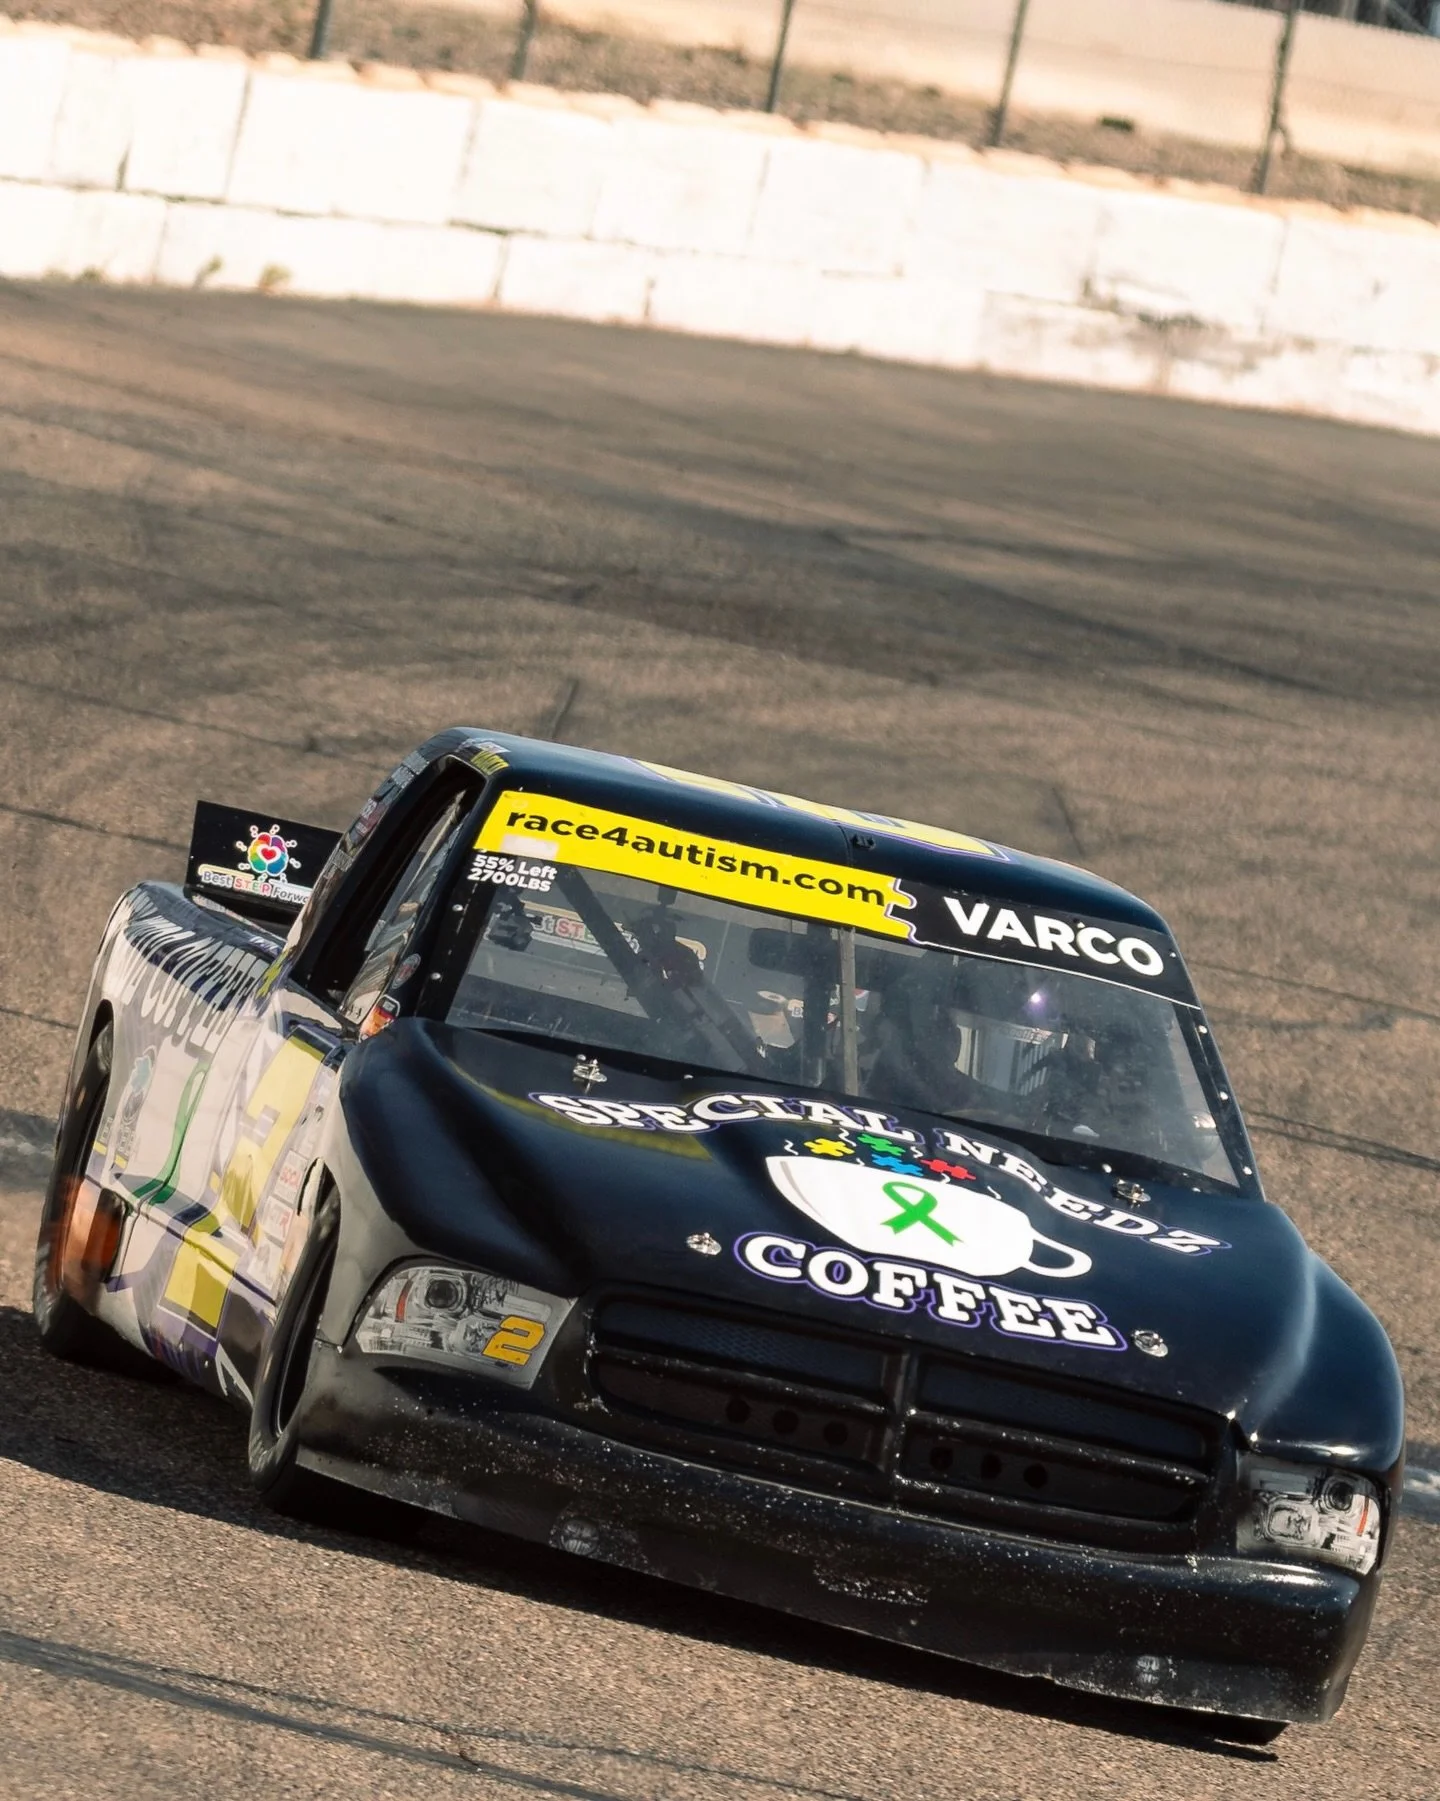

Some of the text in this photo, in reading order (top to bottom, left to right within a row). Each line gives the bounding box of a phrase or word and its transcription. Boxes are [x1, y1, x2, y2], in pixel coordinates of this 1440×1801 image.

[203, 870, 232, 887] Best
[466, 867, 552, 893] 2700LBS
[472, 854, 558, 880] 55% Left
[506, 808, 886, 908] race4autism.com
[943, 896, 1164, 977] VARCO
[535, 1093, 1222, 1254] SPECIAL NEEDZ
[742, 1234, 1119, 1347] COFFEE
[482, 1313, 546, 1366] 2
